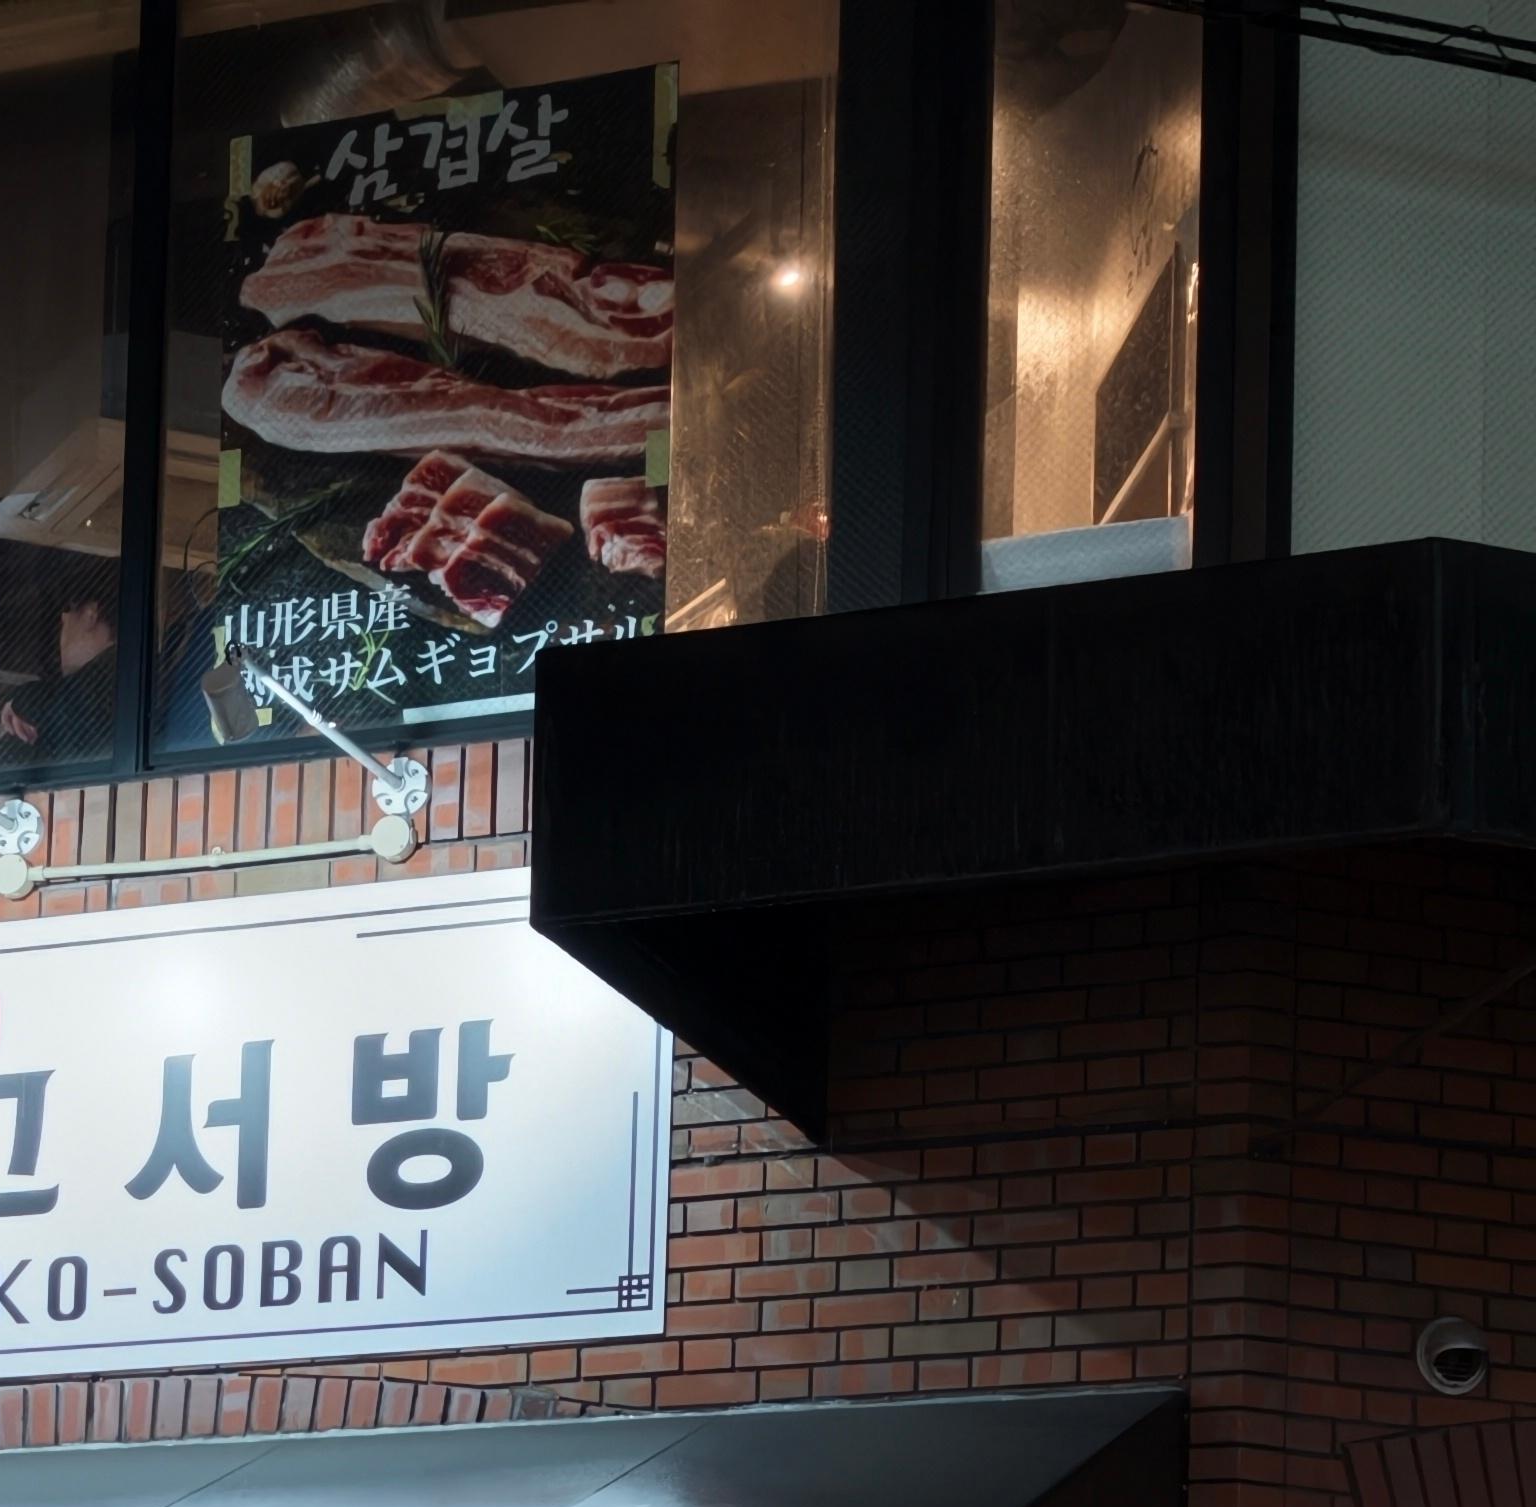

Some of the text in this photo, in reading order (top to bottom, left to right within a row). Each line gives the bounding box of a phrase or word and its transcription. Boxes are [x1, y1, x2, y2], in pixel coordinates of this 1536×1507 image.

[326, 94, 569, 206] 삼겹살
[224, 584, 412, 648] 山形県産
